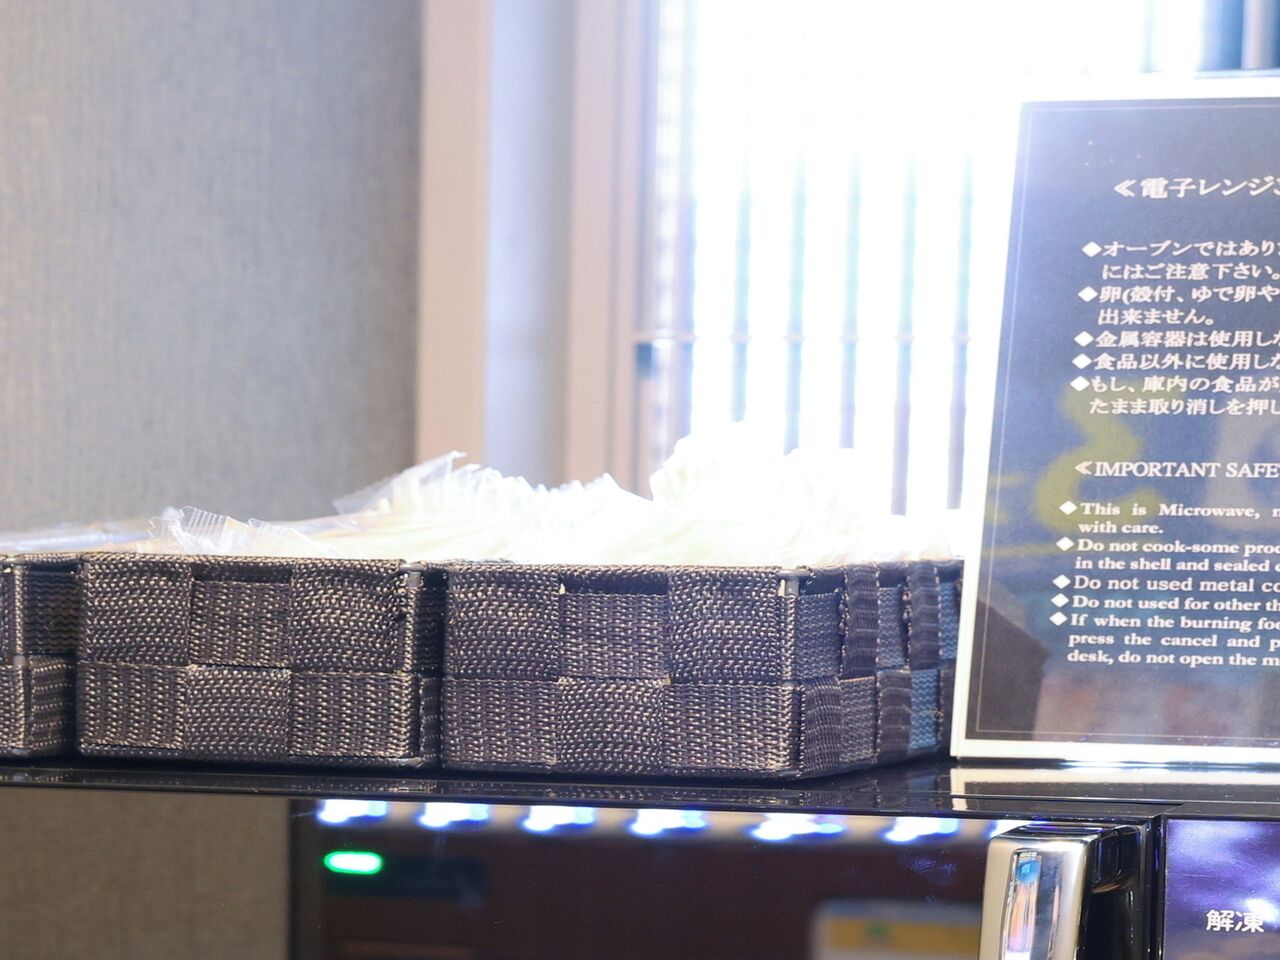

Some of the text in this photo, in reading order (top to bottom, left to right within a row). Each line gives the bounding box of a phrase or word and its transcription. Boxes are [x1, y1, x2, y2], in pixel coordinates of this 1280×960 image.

[1098, 308, 1213, 325] 出来ません。
[1080, 503, 1120, 515] This
[1132, 503, 1146, 515] is
[1159, 504, 1260, 519] Microwave,
[1078, 521, 1163, 533] with care.
[1077, 539, 1104, 551] Do
[1109, 541, 1139, 553] not
[1142, 540, 1239, 553] cook-some
[1075, 557, 1092, 568] in
[1098, 557, 1125, 569] the
[1130, 558, 1171, 570] shell
[1176, 559, 1209, 570] and
[1214, 559, 1270, 571] sealed
[1074, 575, 1101, 589] Do
[1108, 578, 1139, 590] not
[1147, 578, 1192, 591] used
[1200, 579, 1254, 592] metal
[1073, 595, 1099, 607] Do
[1104, 597, 1132, 609] not
[1138, 597, 1179, 609] used
[1184, 597, 1209, 609] for
[1214, 599, 1261, 610] other
[1071, 614, 1088, 626] If
[1094, 615, 1141, 627] when
[1147, 615, 1174, 627] the
[1181, 616, 1252, 633] burning
[1069, 635, 1114, 647] press
[1124, 633, 1151, 645] the
[1161, 635, 1217, 646] cancel
[1227, 636, 1260, 647] and
[1067, 650, 1113, 664] desk,
[1118, 651, 1141, 662] do
[1146, 652, 1174, 664] not
[1179, 656, 1223, 668] open
[1229, 653, 1257, 665] the
[1206, 909, 1265, 933] 解凍
